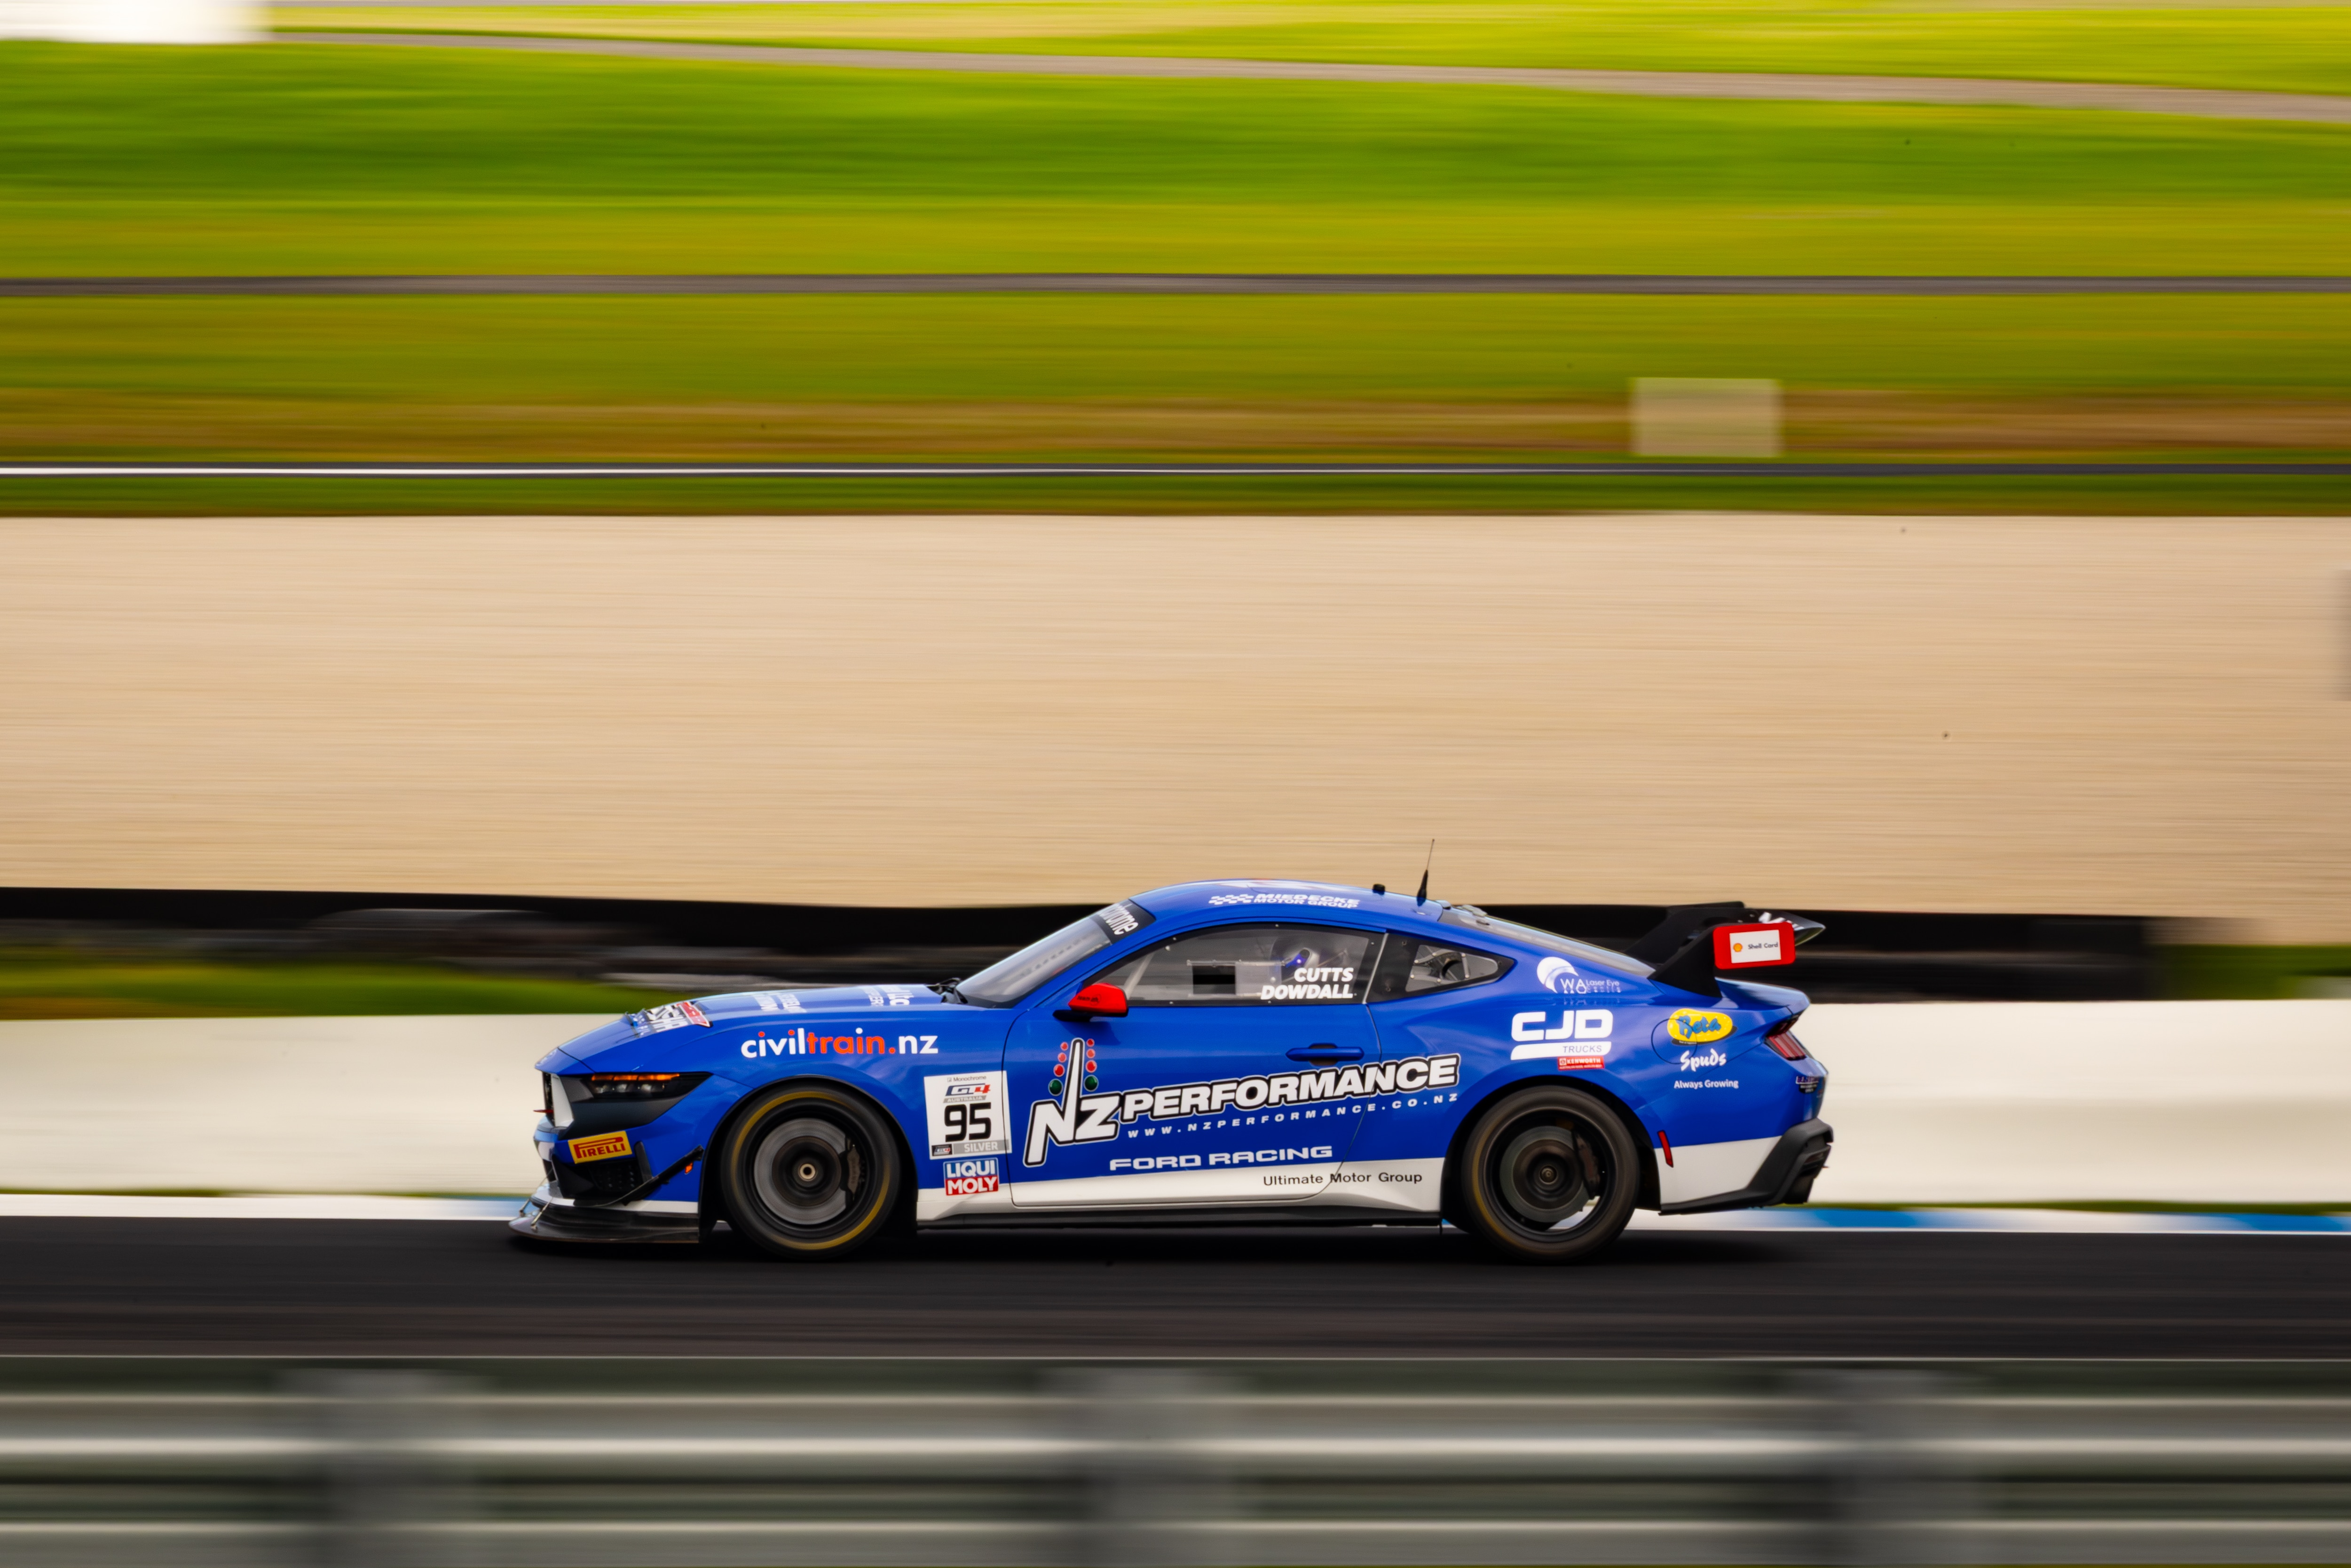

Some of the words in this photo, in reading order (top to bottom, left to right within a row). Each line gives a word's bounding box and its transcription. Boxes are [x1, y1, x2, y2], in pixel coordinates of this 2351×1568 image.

[1256, 894, 1360, 905] MIEDECKE
[1294, 968, 1354, 982] CUTTS
[1261, 984, 1353, 1000] DOWDALL
[1560, 978, 1587, 994] WA
[1511, 1009, 1613, 1041] CJD
[741, 1027, 939, 1058] civiltrain.nz
[1680, 1048, 1727, 1072] Spuds
[1674, 1080, 1703, 1089] Always
[1704, 1079, 1739, 1089] Growing
[944, 1102, 992, 1142] 95
[1128, 1093, 1458, 1138] WWW.NZPERFORMANCE.CO.NZ
[573, 1137, 626, 1158] PIRELLI
[964, 1142, 998, 1152] SILVER
[1110, 1155, 1201, 1171] FORD
[1209, 1146, 1333, 1166] RACING
[947, 1160, 995, 1178] LIQUI
[947, 1176, 997, 1195] MOLY
[1263, 1174, 1324, 1186] Ultimate
[1330, 1173, 1372, 1183] Motor
[1379, 1172, 1422, 1184] Group
